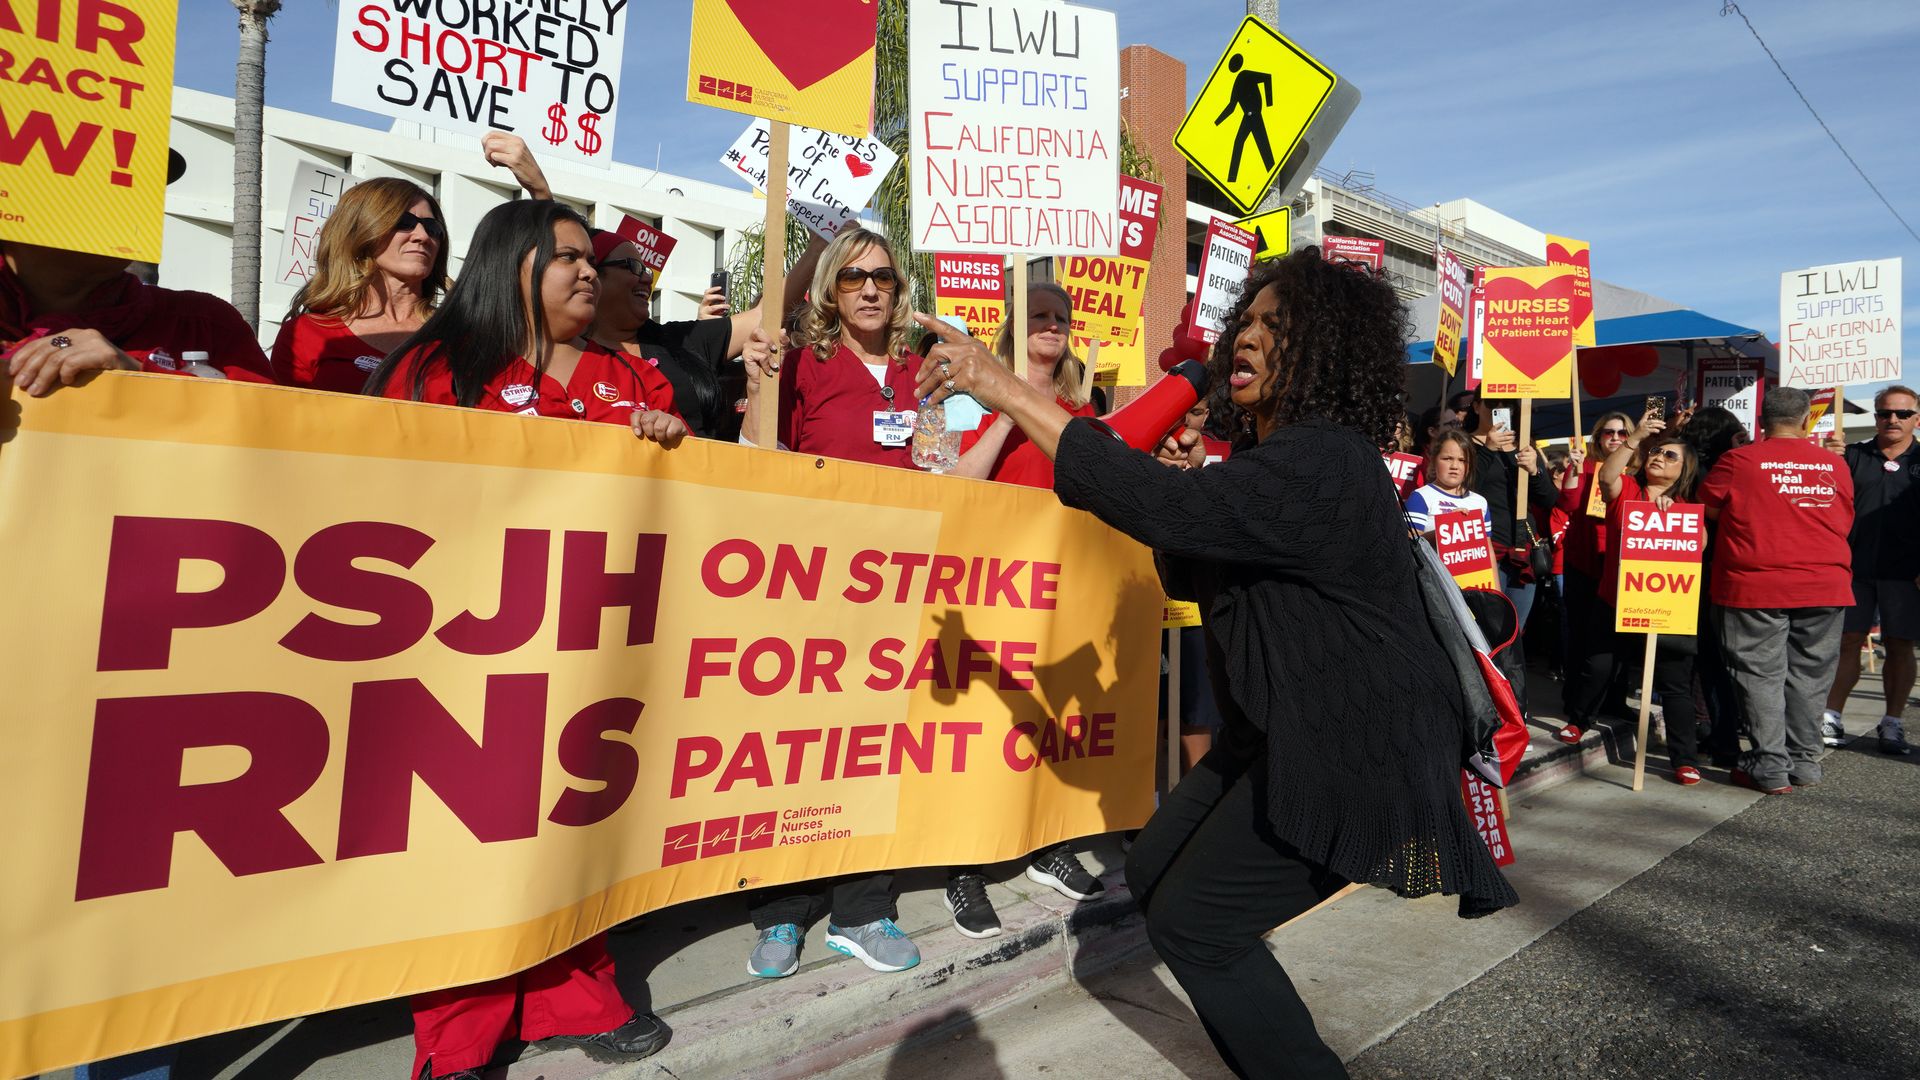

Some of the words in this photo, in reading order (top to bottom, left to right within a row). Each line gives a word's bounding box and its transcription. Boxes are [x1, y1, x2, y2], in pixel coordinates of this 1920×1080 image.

[392, 0, 599, 68] WORKED
[940, 0, 1079, 59] ILWU
[352, 4, 543, 92] SHORT
[552, 61, 614, 114] TO
[377, 58, 515, 132] SAVE
[942, 63, 1087, 110] SUPPORTS
[815, 130, 841, 158] The
[924, 111, 1108, 160] CALIFORNIA
[926, 155, 1062, 200] NURSES
[812, 178, 850, 219] Care
[922, 202, 1113, 249] ASSOCIATION
[1213, 219, 1239, 234] California
[1238, 229, 1255, 242] Nurses
[636, 229, 659, 248] ON
[940, 260, 1000, 276] NURSES
[1210, 243, 1249, 269] PATIENTS
[940, 276, 1001, 291] DEMAND
[1069, 256, 1144, 290] DON'T
[1445, 257, 1467, 289] SOME
[1797, 265, 1879, 297] ILWU
[1066, 285, 1127, 319] HEAL
[1443, 279, 1463, 309] CUTS
[1488, 298, 1570, 314] NURSES
[954, 305, 1001, 324] FAIR
[1797, 295, 1883, 320] SUPPORTS
[1487, 329, 1500, 338] of
[1501, 328, 1540, 338] Patient
[1543, 327, 1569, 337] Care
[1488, 316, 1509, 326] Are
[1512, 316, 1532, 326] the
[1535, 315, 1569, 326] Heart
[1788, 318, 1896, 342] CALIFORNIA
[1436, 330, 1456, 357] HEAL
[1789, 339, 1867, 363] NURSES
[1705, 376, 1755, 388] PATIETS
[1786, 356, 1899, 387] ASSOCIATION
[504, 386, 533, 397] STRIKE
[886, 433, 901, 441] RN
[1760, 462, 1834, 472] #Medicare4All
[1771, 474, 1802, 484] Heal
[1778, 484, 1834, 496] America
[1438, 519, 1485, 546] SAFE
[1628, 511, 1698, 533] SAFE
[1442, 546, 1488, 566] STAFFING
[1626, 537, 1698, 552] STAFFING
[700, 538, 828, 602] ON
[842, 548, 1062, 610] STRIKE
[1624, 572, 1695, 594] NOW
[96, 515, 667, 672] PSJH
[1622, 607, 1672, 617] #SafeStaffing
[683, 636, 847, 699] FOR
[863, 636, 1037, 691] SAFE
[669, 721, 983, 799] PATIENT
[1002, 712, 1117, 772] CARE
[783, 804, 842, 820] California
[779, 828, 852, 847] Association
[780, 820, 823, 833] Nurses
